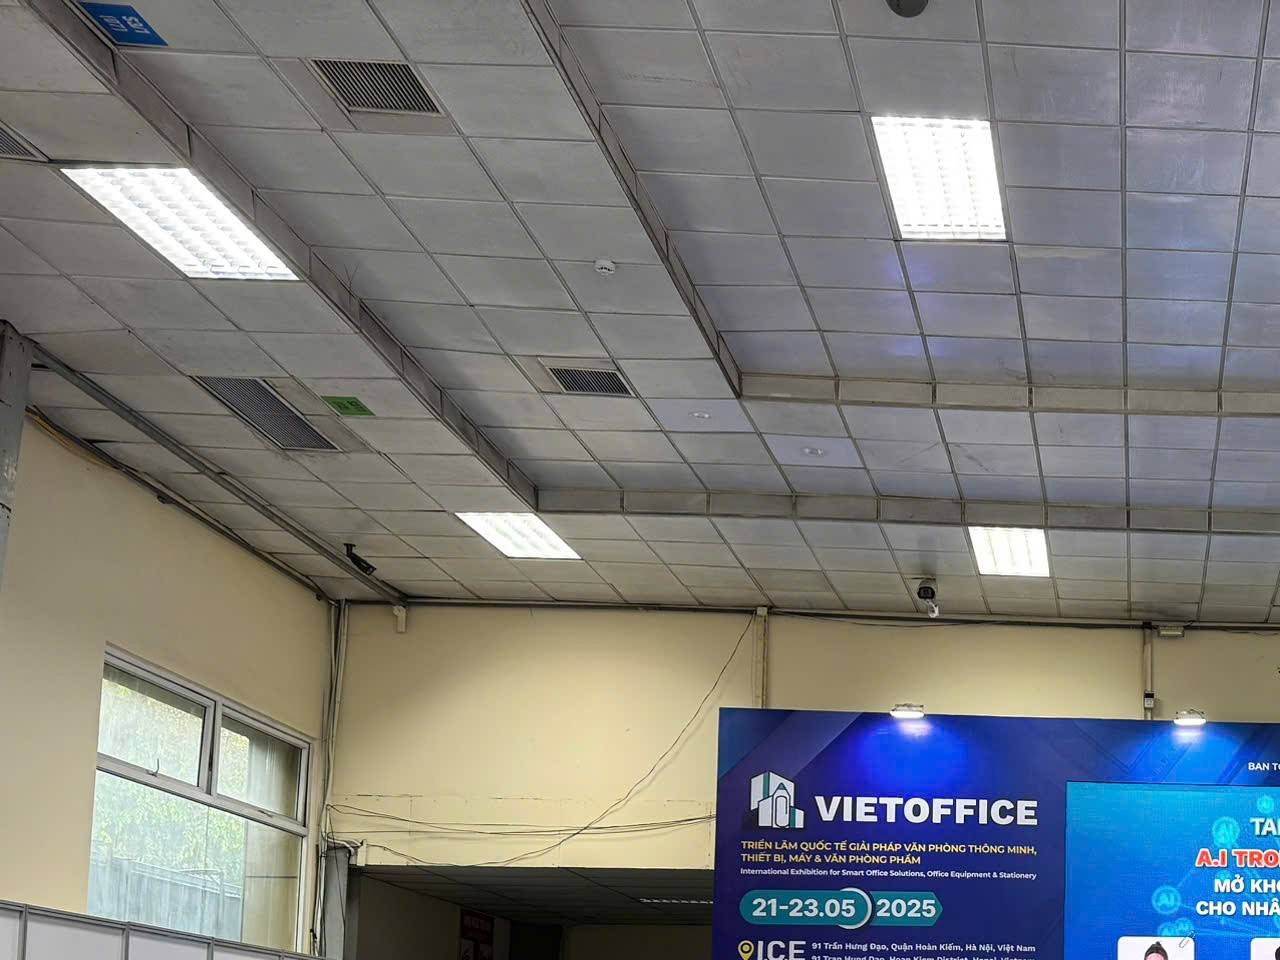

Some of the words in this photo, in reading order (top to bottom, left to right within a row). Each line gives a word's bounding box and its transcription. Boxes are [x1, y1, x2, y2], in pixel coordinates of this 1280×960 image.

[1248, 762, 1270, 771] BAN
[815, 796, 1038, 825] VIETOFFICE
[775, 840, 798, 850] LÃM
[800, 840, 832, 851] QUỐC
[834, 840, 847, 851] TẾ
[872, 842, 902, 852] PHÁP
[903, 842, 926, 852] VĂN
[928, 842, 966, 853] PHÒNG
[968, 843, 1005, 854] THÔNG
[1007, 846, 1038, 856] MINH,
[741, 851, 771, 862] THIẾT
[774, 853, 787, 864] BỊ,
[789, 852, 812, 862] MÁY
[814, 854, 822, 863] &
[824, 853, 847, 863] VĂN
[849, 853, 888, 864] PHÒNG
[1196, 848, 1227, 868] A.I
[790, 868, 828, 876] Exhibition
[829, 868, 840, 876] for
[889, 870, 926, 878] Solutions,
[951, 870, 991, 879] Equipment
[999, 871, 1037, 880] Stationery
[1214, 874, 1245, 893] MỞ
[752, 898, 856, 917] 21-23.05
[876, 899, 936, 918] 2025
[1196, 901, 1236, 916] CHO
[845, 942, 868, 951] Hưng
[869, 943, 889, 951] Đạo,
[891, 943, 913, 952] Quận
[915, 943, 937, 951] Hoàn
[940, 942, 964, 952] Kiếm,
[979, 944, 996, 953] Nội,
[997, 944, 1014, 953] Việt
[1016, 944, 1036, 952] Nam
